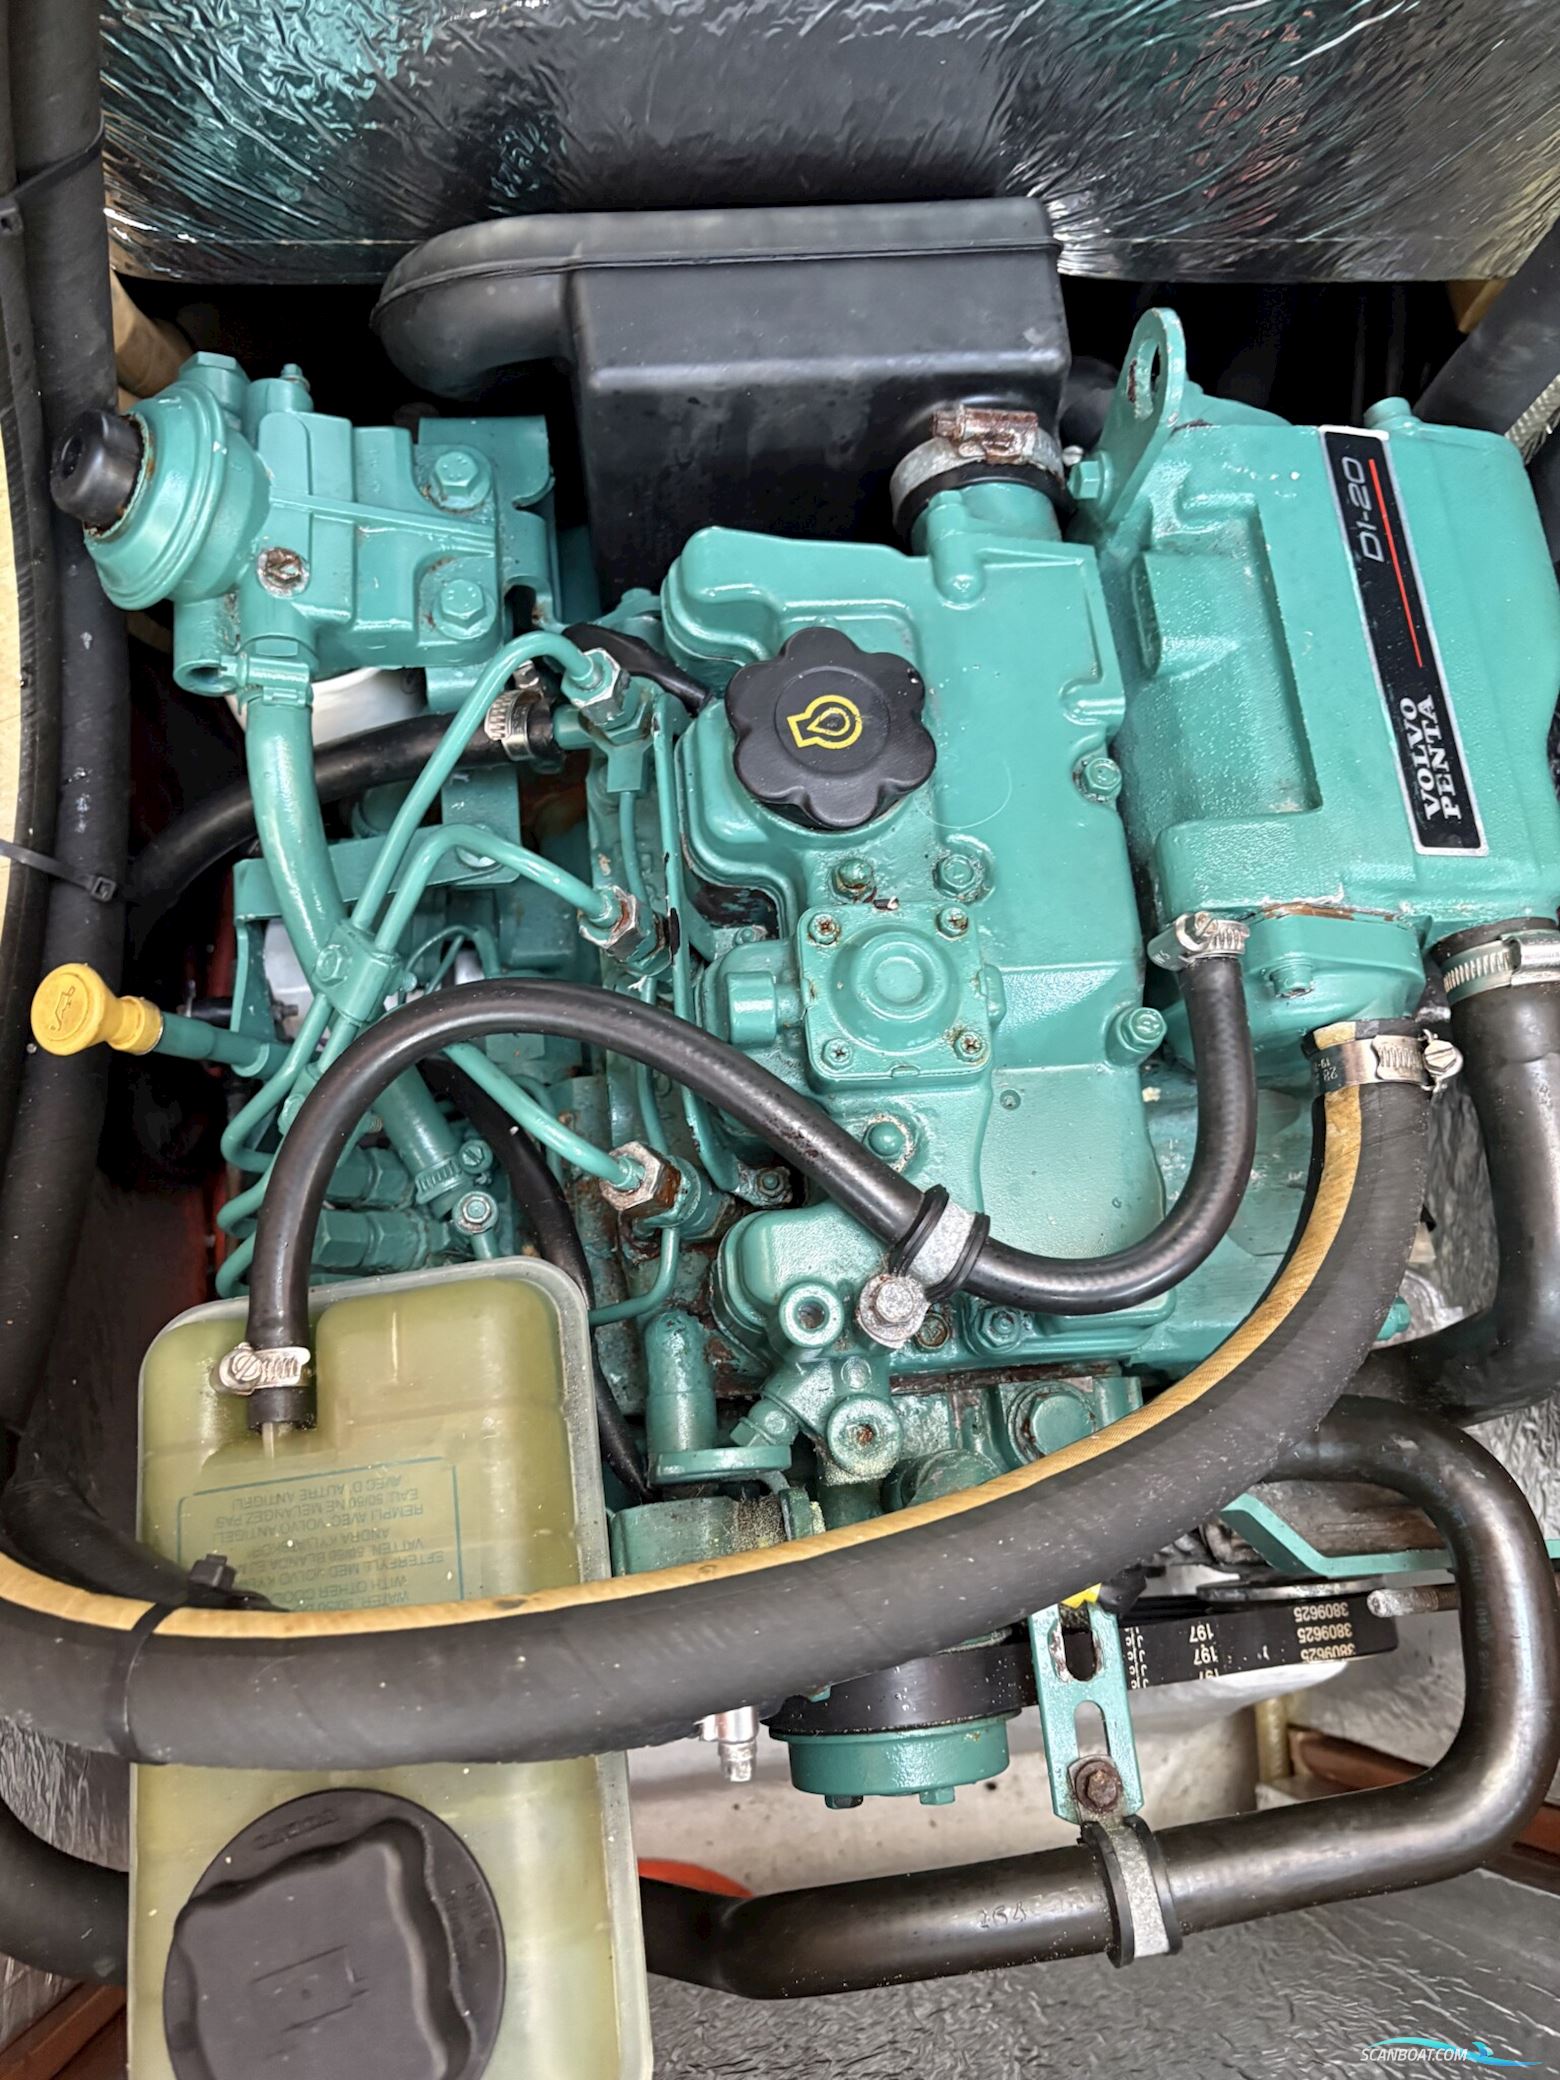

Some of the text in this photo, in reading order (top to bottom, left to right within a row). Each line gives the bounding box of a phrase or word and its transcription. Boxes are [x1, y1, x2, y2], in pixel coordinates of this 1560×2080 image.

[1342, 456, 1384, 562] D1-20
[1400, 697, 1441, 820] VOLVO
[1417, 694, 1461, 820] PENTA
[368, 1476, 401, 1490] AVEC
[300, 1484, 344, 1500] AUTRE
[246, 1503, 321, 1524] MELANGEZ
[327, 1500, 344, 1511] NE
[372, 1504, 423, 1521] REMPLI
[216, 1515, 241, 1529] PAS
[281, 1519, 323, 1534] VOLVO
[332, 1512, 366, 1526] AVEC
[343, 1528, 390, 1543] ANDRA
[271, 1553, 325, 1569] BLANDA
[364, 1551, 443, 1573] EFTERFYLL
[331, 1564, 358, 1577] MED
[320, 1582, 366, 1597] OTHER
[1293, 1602, 1349, 1622] 3809625
[1189, 1623, 1214, 1643] 197
[1297, 1623, 1353, 1643] 3809625
[1193, 1645, 1218, 1665] 197
